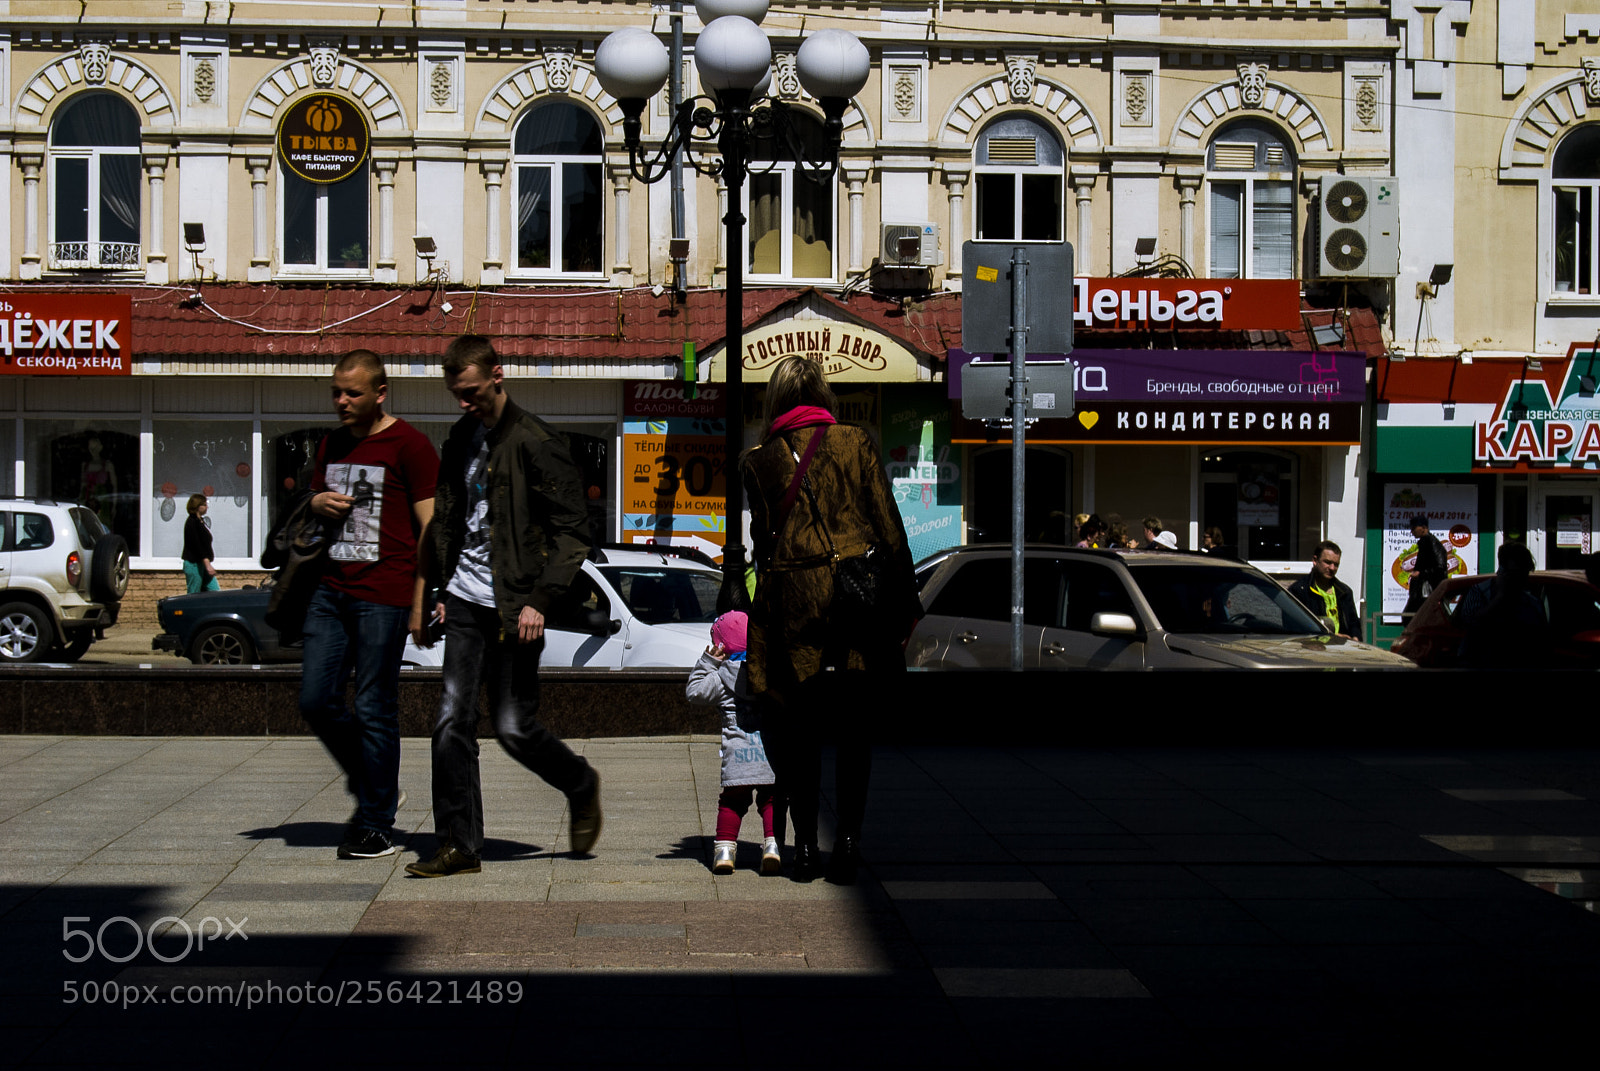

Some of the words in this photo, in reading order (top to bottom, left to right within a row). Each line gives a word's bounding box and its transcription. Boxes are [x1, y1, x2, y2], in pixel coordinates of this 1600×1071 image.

[289, 135, 357, 151] ТЫКВА
[313, 154, 355, 163] БЫСТРОГО
[305, 163, 341, 171] ПИТАНИЯ
[746, 327, 831, 365] ГОСТИНЫЙ
[837, 333, 882, 363] ДВОР
[17, 356, 123, 370] СЕКОНД-ХЕНД
[1146, 379, 1204, 395] Бренды,
[1207, 379, 1284, 393] свободные
[1288, 383, 1303, 393] от
[634, 402, 675, 414] САЛОН
[677, 403, 715, 415] ОБУВИ
[1506, 409, 1582, 420] ПЕНЗЕНСКАЯ
[1117, 411, 1331, 432] КОНДИТЕРСКАЯ
[634, 440, 681, 453] ТЁПЛЫЕ
[634, 464, 651, 475] ДО
[891, 466, 952, 480] АПТЕКА
[633, 499, 648, 509] НА
[649, 500, 682, 510] ОБУВЬ
[684, 501, 693, 510] И
[1427, 511, 1445, 520] МАЯ
[1447, 511, 1466, 520] 2018
[908, 515, 953, 537] ЗДОРОВ!
